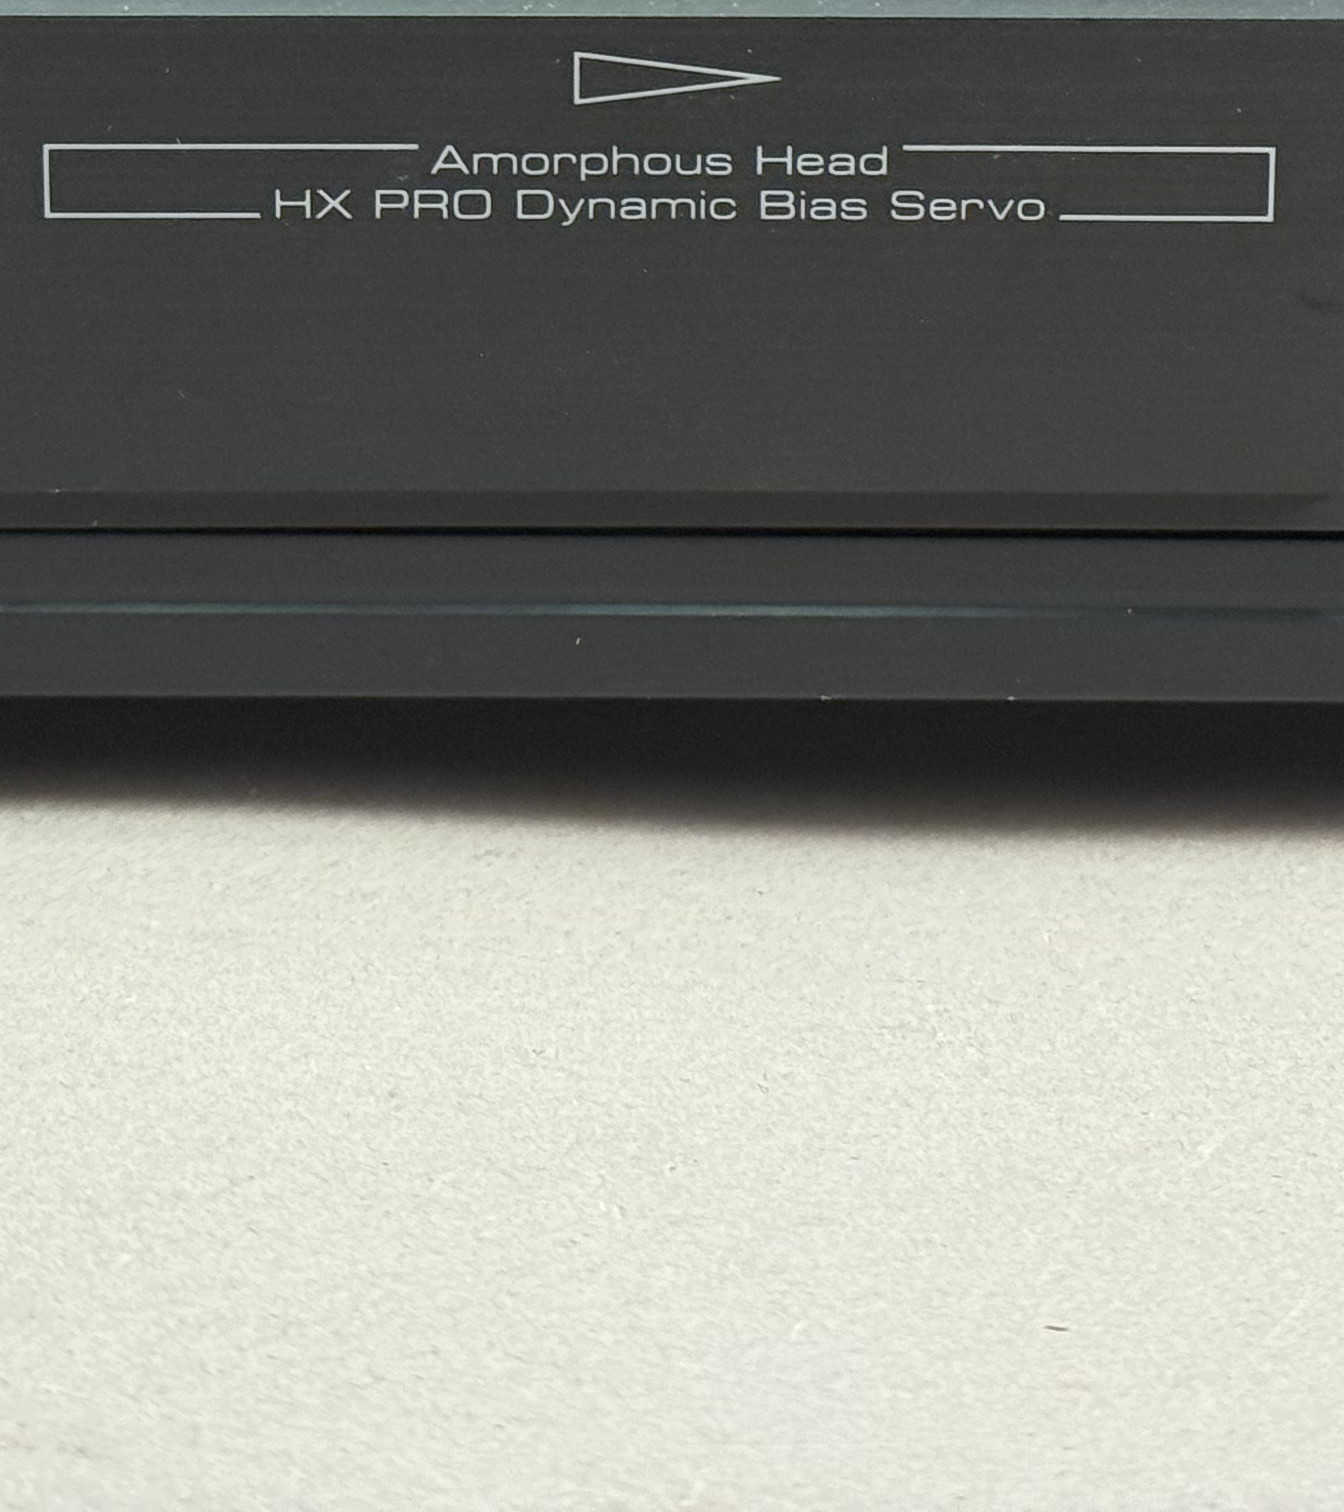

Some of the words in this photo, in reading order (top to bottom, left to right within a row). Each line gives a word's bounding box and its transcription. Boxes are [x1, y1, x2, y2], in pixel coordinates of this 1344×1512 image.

[430, 144, 733, 182] Amorphous
[756, 145, 888, 176] Head
[274, 188, 353, 220] HX
[375, 189, 492, 220] PRO
[516, 189, 737, 227] Dynamic
[760, 190, 868, 221] Bias
[890, 190, 1046, 221] Servo
